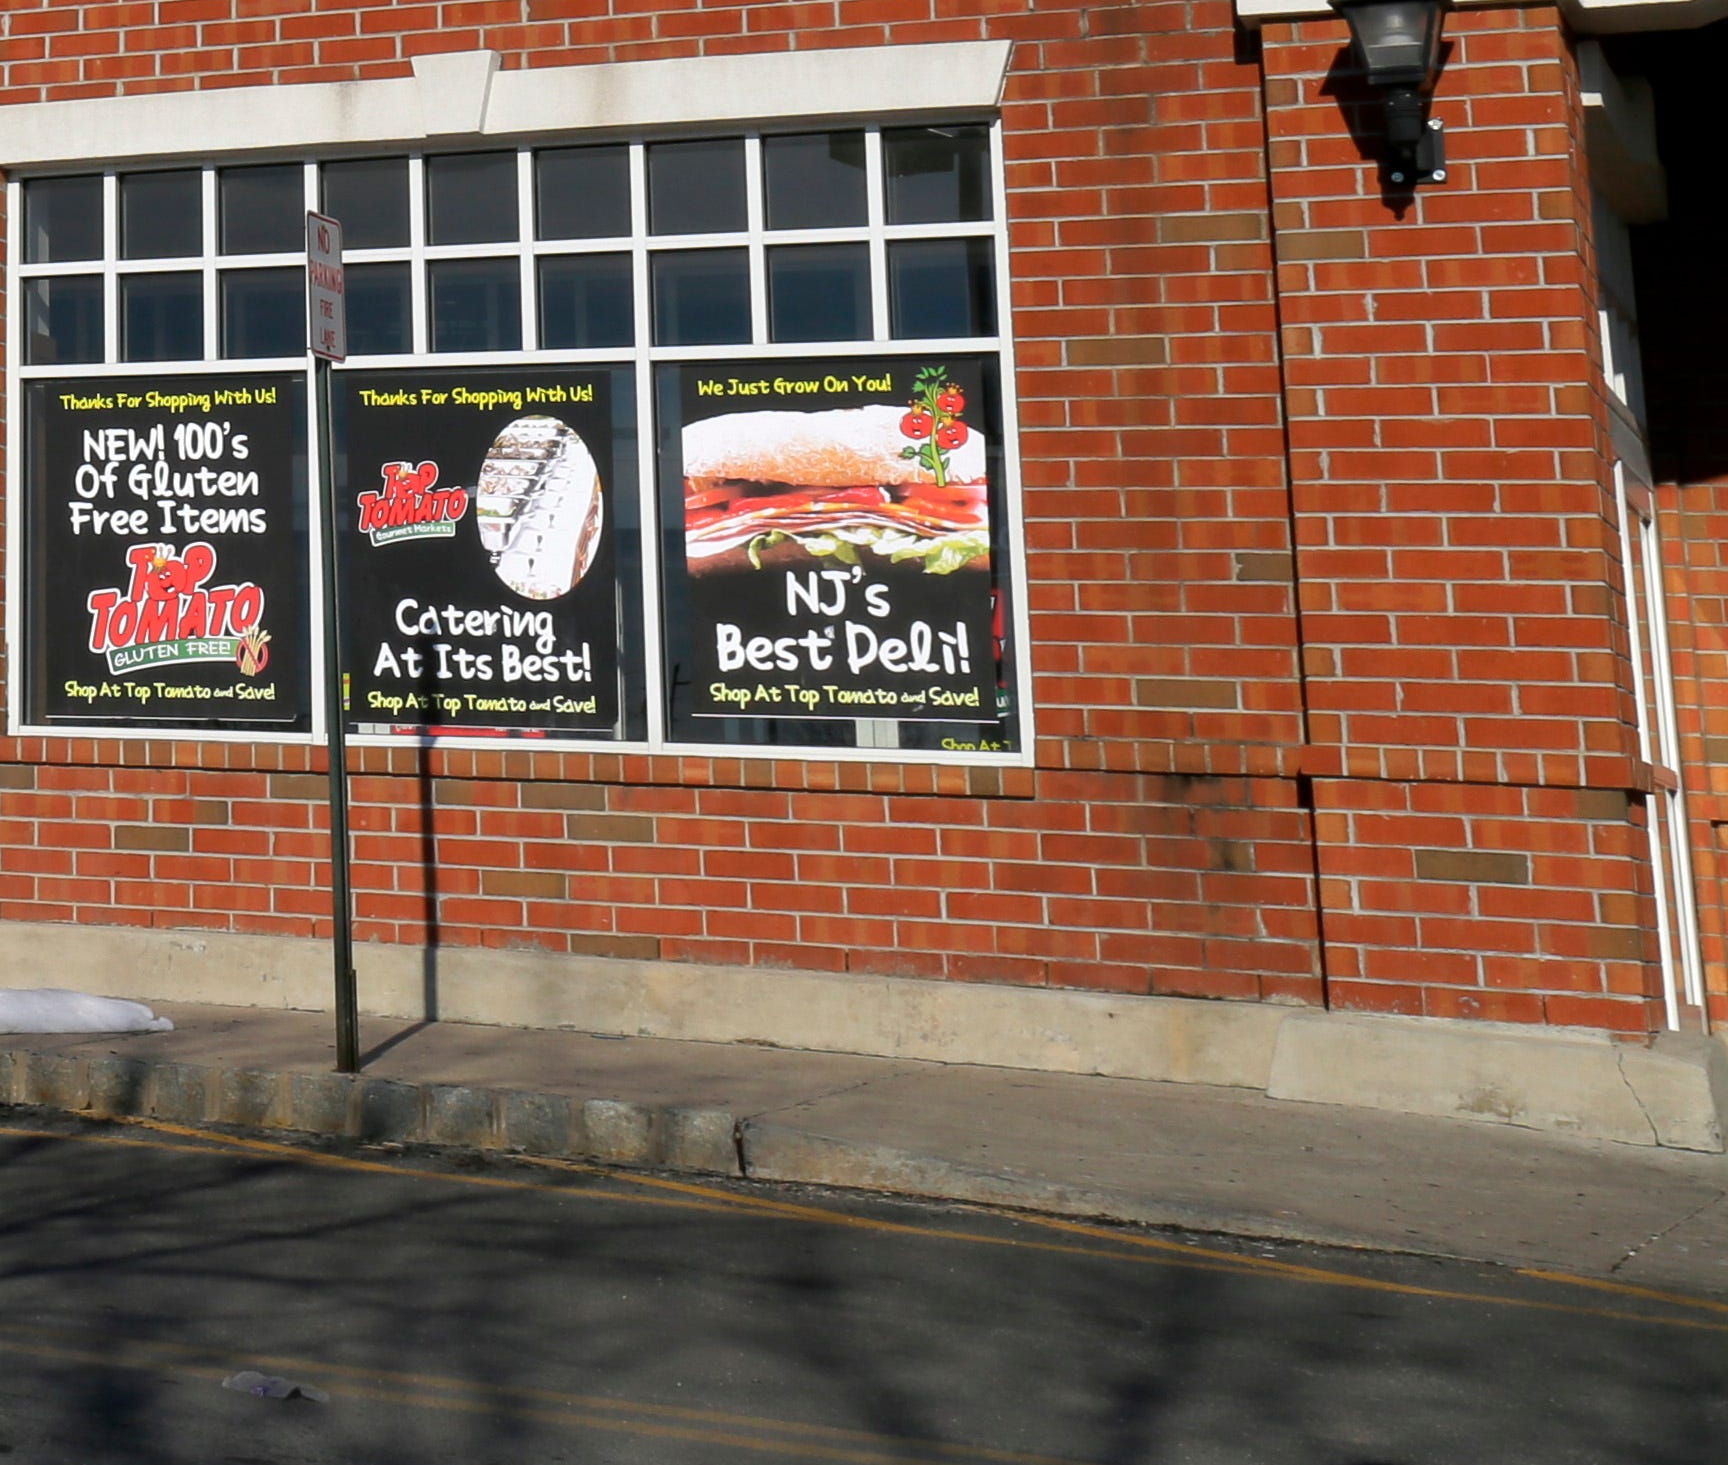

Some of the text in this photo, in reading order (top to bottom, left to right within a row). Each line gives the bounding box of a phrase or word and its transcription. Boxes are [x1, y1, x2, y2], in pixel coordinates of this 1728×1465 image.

[318, 225, 329, 254] NO
[310, 260, 344, 295] PARKING
[320, 299, 334, 319] FIRE
[320, 327, 336, 348] LANE
[60, 387, 277, 413] Thanks For Shopping With Us!
[360, 384, 593, 410] Thanks For Shopping With Us!
[698, 373, 892, 396] We Just Grow On You!
[83, 424, 165, 462] NEW!
[75, 460, 259, 500] Of Gluten
[68, 500, 267, 535] Free Items
[358, 486, 468, 533] TOMATO
[786, 565, 890, 618] NJ's
[87, 582, 264, 654] TOMATO
[396, 598, 556, 654] Catering
[114, 643, 179, 667] GLUTEN
[373, 642, 592, 682] At Its Best!
[716, 620, 971, 675] Best Deli!
[64, 681, 275, 705] Shop At Top Tomato and Save!
[368, 690, 596, 717] Shop At Top Tomato and Save!
[710, 683, 751, 710] Shop
[754, 684, 782, 703] At
[785, 685, 820, 711] Top
[823, 685, 897, 705] Tomato
[901, 690, 926, 704] and
[929, 686, 980, 707] Save!
